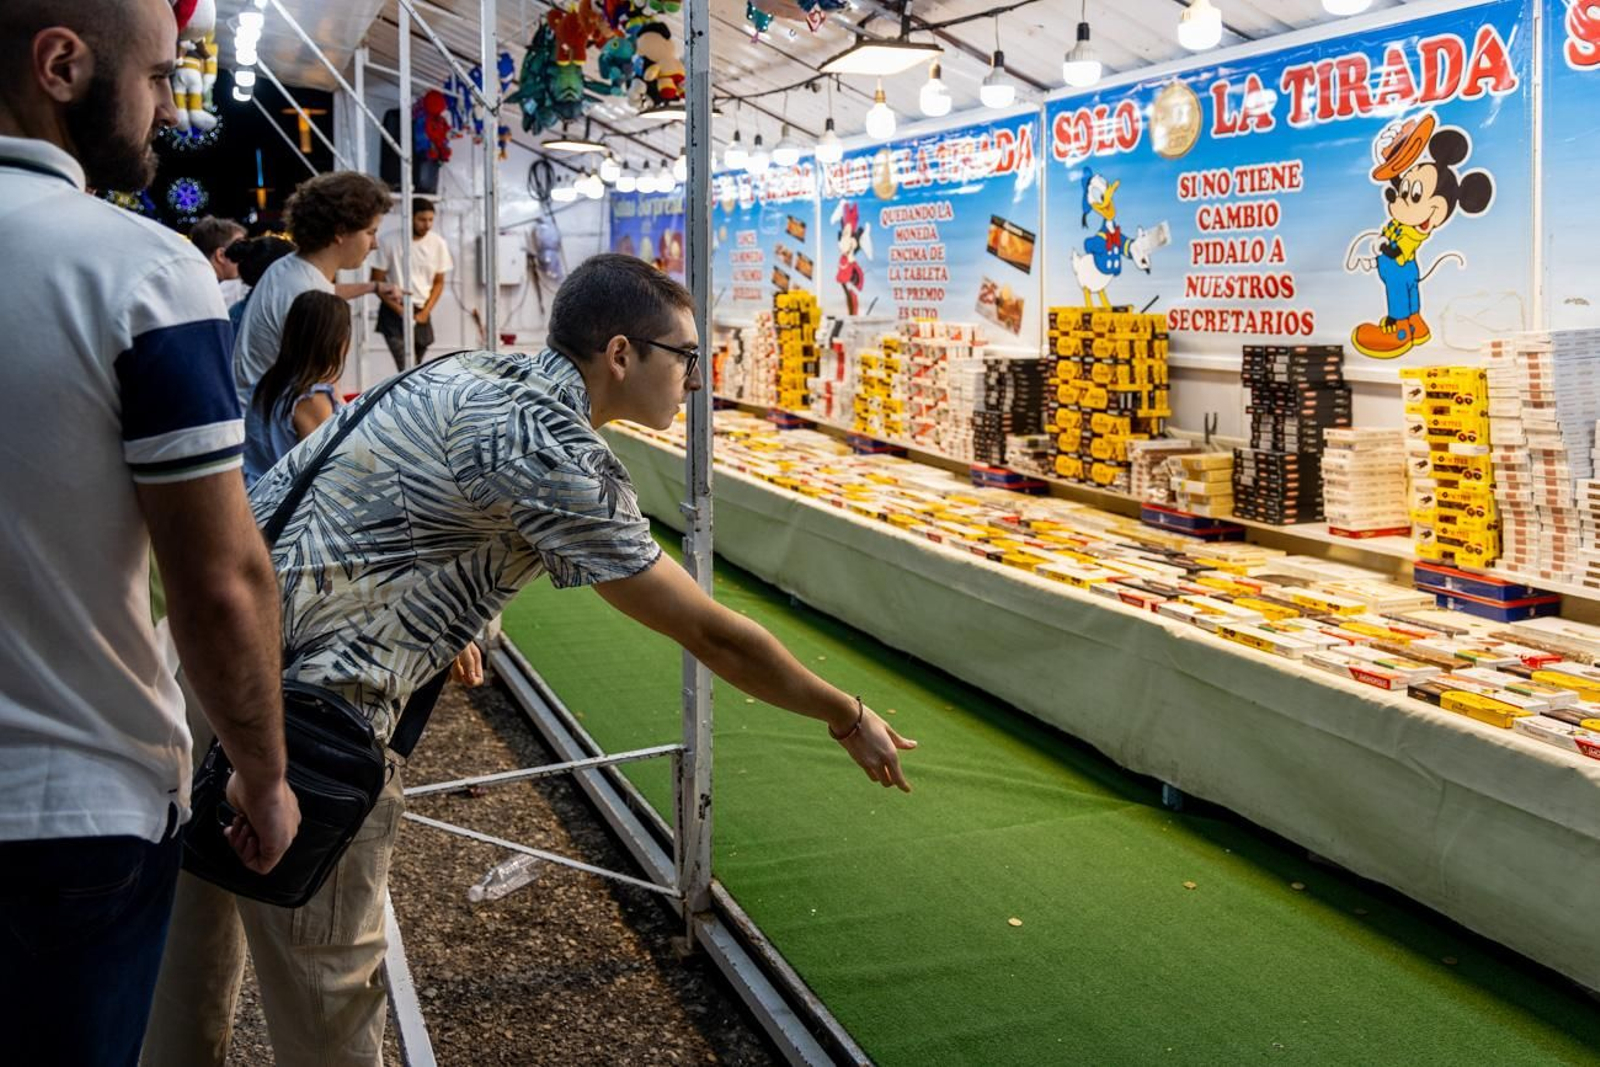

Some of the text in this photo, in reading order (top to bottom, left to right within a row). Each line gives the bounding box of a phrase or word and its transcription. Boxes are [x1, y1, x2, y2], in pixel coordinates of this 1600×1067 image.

[1054, 26, 1517, 159] SOLO LA TIRADA
[1179, 163, 1301, 199] SI NO TIENE
[937, 203, 952, 219] LA
[1198, 202, 1279, 231] CAMBIO
[895, 225, 938, 242] MONEDA
[890, 245, 945, 261] ENCIMA DE
[1192, 237, 1285, 265] PIDALO A
[888, 266, 948, 281] LA TABLETA
[893, 287, 945, 301] EL PREMIO
[1185, 274, 1295, 299] NUESTROS
[1168, 308, 1315, 336] SECRETARIOS
